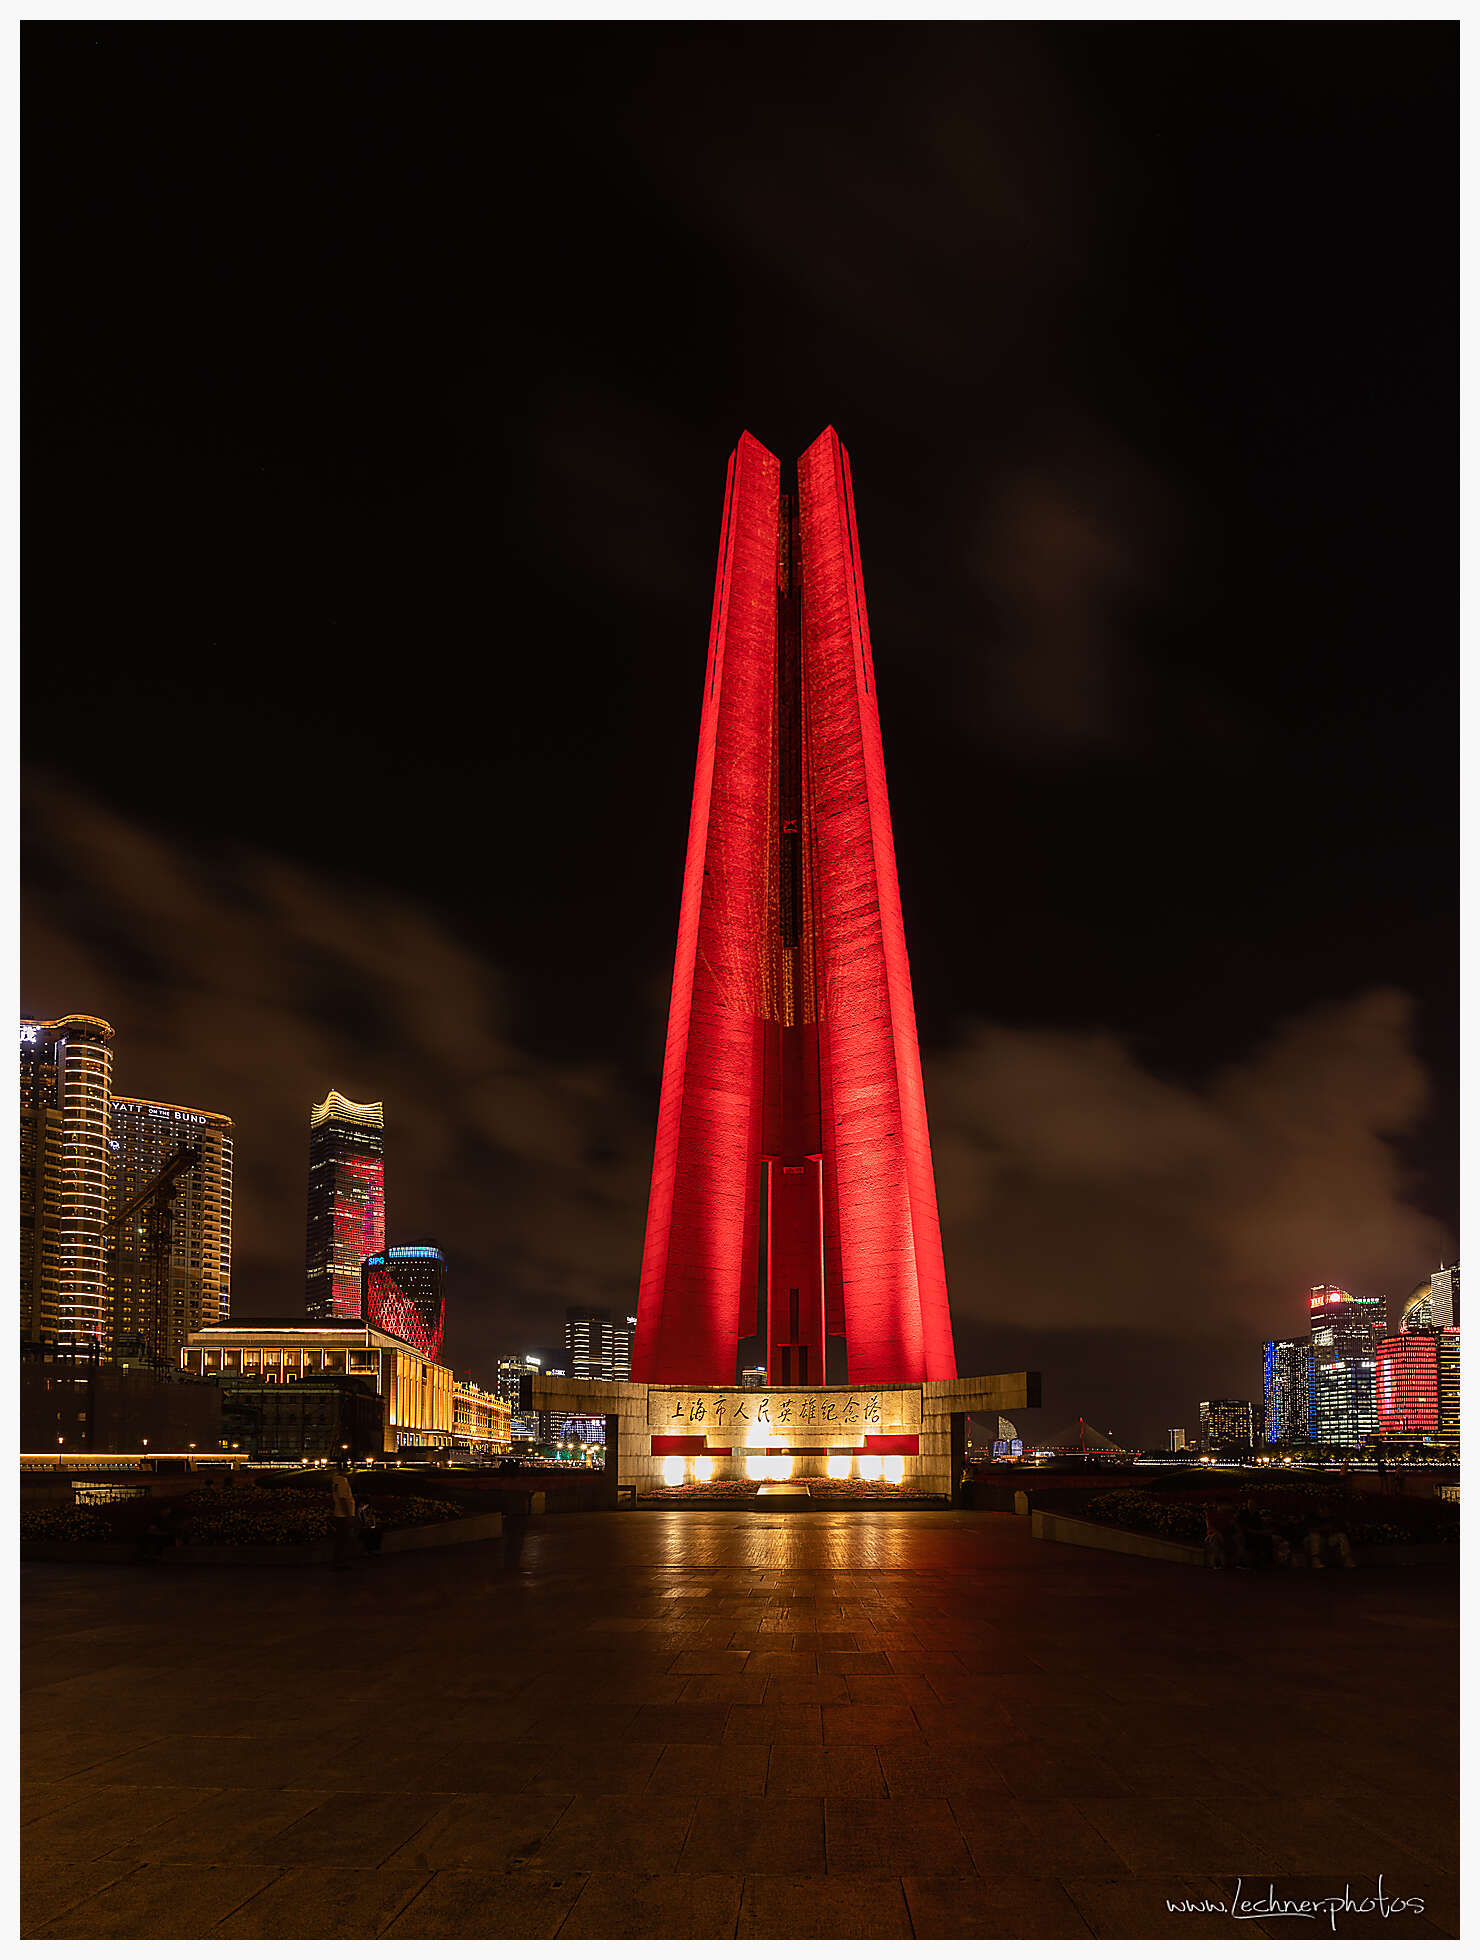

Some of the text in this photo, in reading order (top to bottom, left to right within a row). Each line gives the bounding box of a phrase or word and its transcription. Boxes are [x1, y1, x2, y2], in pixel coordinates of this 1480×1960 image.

[174, 1111, 207, 1124] BUND
[368, 1256, 385, 1265] SIPG
[671, 1394, 882, 1425] 上海市人民英雄纪念塔
